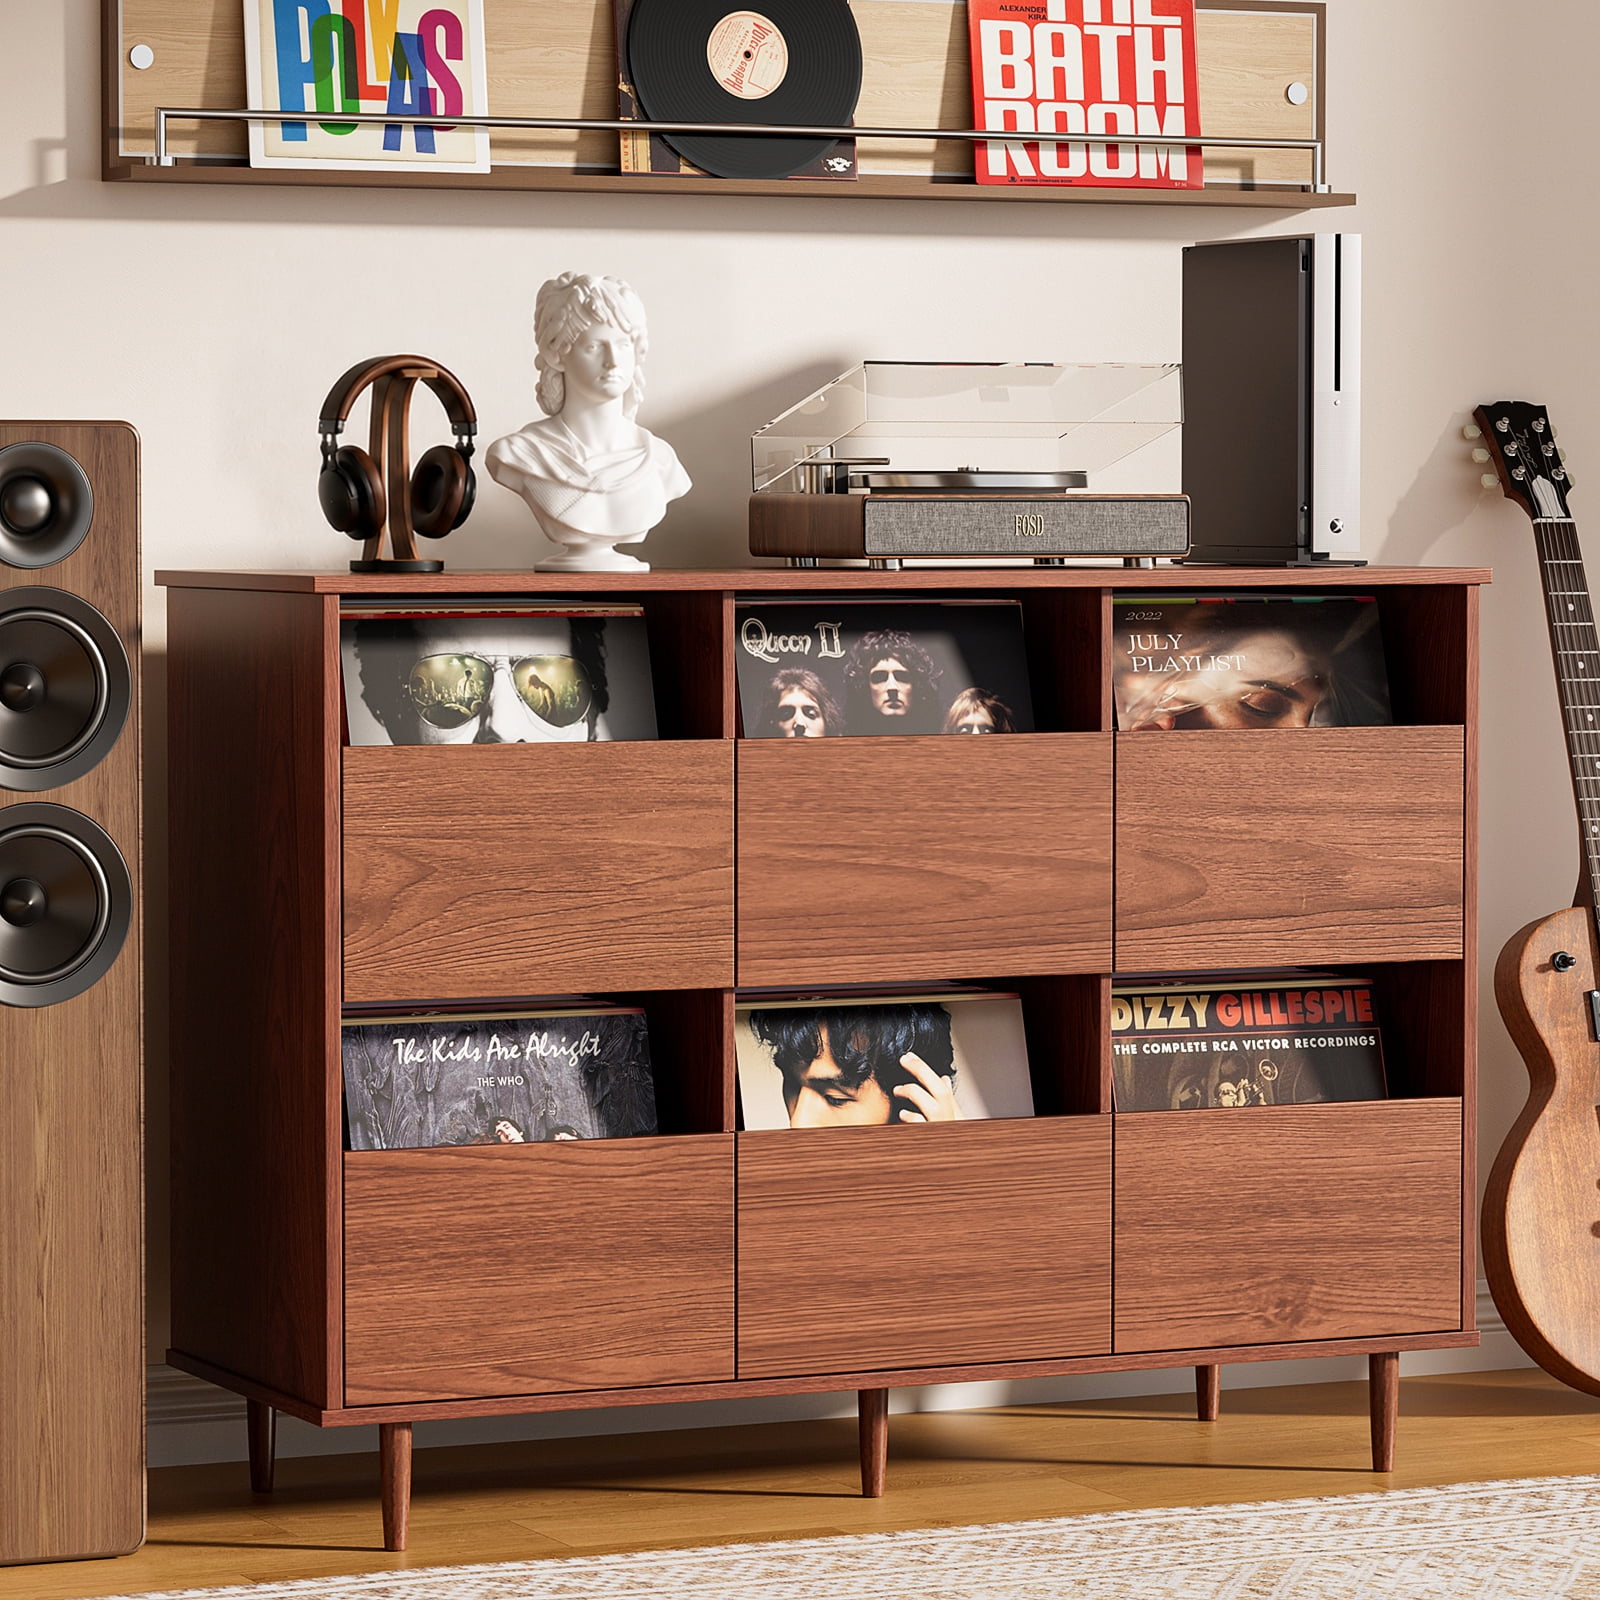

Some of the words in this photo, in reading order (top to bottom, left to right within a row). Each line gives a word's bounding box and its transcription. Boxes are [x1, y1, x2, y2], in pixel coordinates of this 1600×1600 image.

[999, 4, 1047, 13] ALEXANDER
[979, 19, 1185, 104] BATH
[984, 100, 1188, 180] ROOM
[1015, 514, 1044, 536] FOSD
[1125, 611, 1163, 620] 2022
[741, 618, 812, 663] Queen
[1127, 634, 1183, 654] JULY
[1132, 655, 1246, 672] PLAYLIST
[1112, 995, 1210, 1030] DIZZY
[1216, 989, 1373, 1027] GILLESPIE
[393, 1038, 427, 1064] The
[431, 1036, 482, 1062] Kids
[486, 1033, 521, 1062] Are
[526, 1031, 601, 1066] Alright
[1114, 1044, 1137, 1055] THE
[1142, 1041, 1207, 1054] COMPLETE
[1212, 1040, 1238, 1052] RCA
[1242, 1038, 1290, 1051] VICTOR
[1295, 1035, 1376, 1049] RECORDINGS
[477, 1077, 495, 1087] THE
[497, 1075, 524, 1086] WHO
